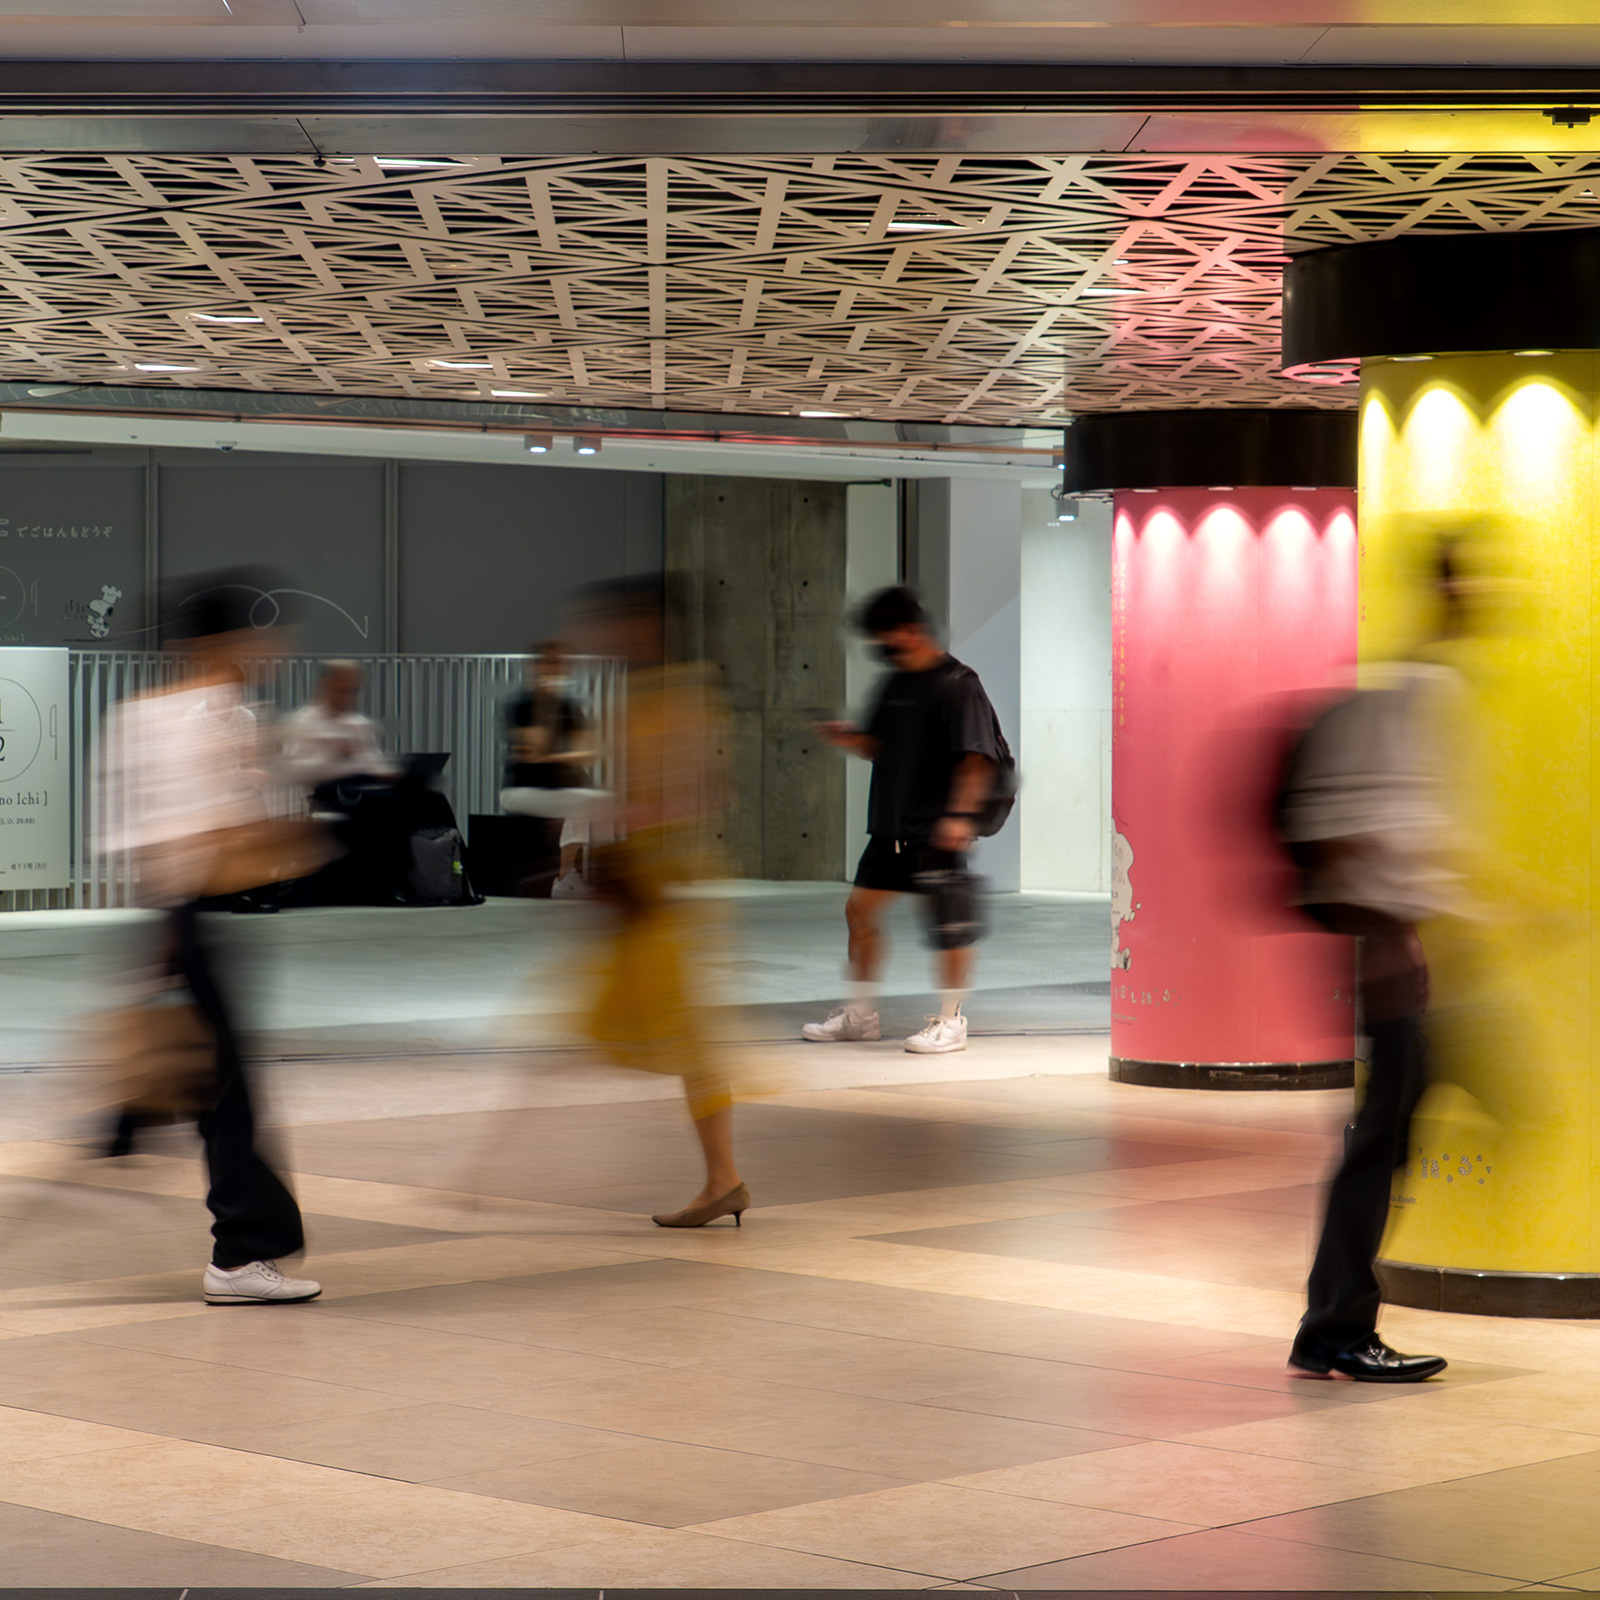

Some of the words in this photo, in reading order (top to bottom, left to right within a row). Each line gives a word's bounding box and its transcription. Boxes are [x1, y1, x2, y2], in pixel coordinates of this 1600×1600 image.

[16, 525, 114, 538] でごはんもどうぞ
